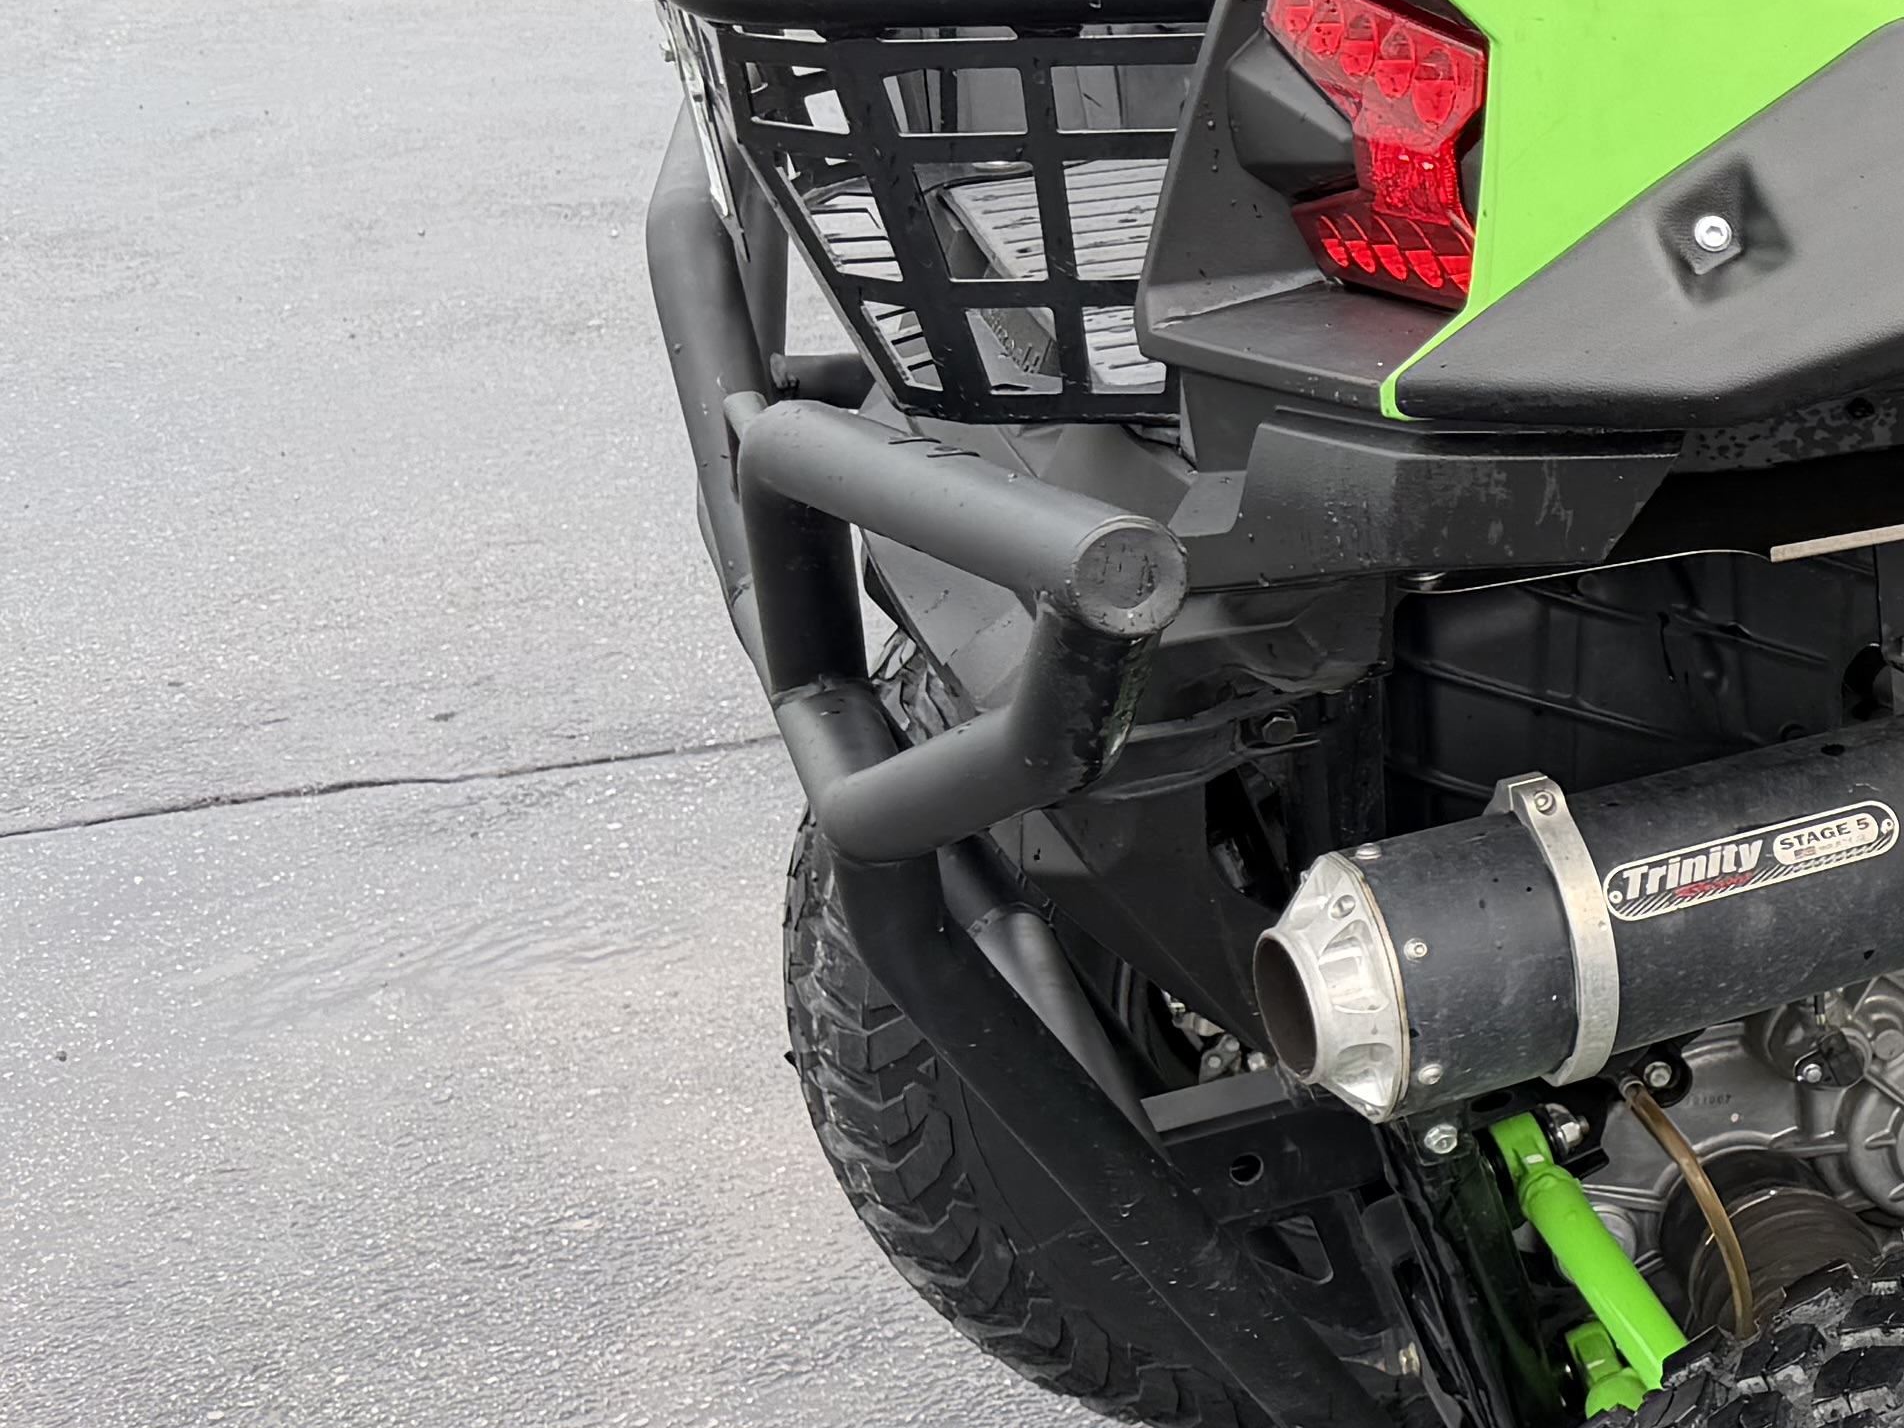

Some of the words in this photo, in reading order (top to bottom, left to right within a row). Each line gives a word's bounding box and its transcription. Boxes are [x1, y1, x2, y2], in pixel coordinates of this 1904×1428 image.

[1778, 823, 1852, 852] STAGE
[1856, 817, 1870, 832] 5
[1621, 838, 1764, 902] Trinity
